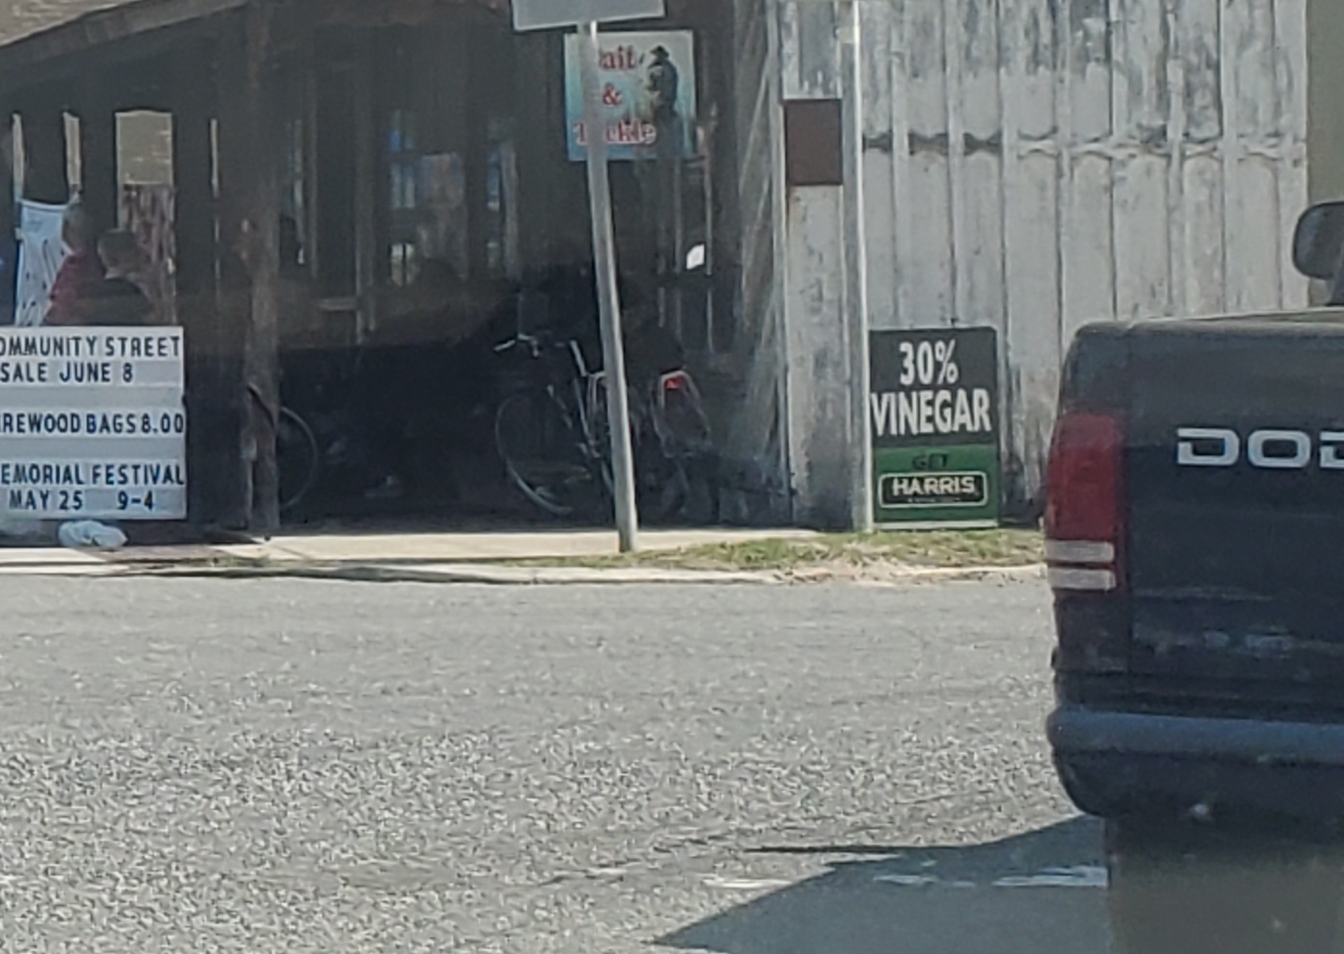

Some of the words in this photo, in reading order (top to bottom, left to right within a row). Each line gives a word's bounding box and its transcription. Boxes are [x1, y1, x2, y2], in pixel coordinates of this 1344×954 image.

[599, 44, 637, 70] ait
[603, 82, 623, 107] &
[573, 119, 657, 145] Tckle
[105, 335, 181, 357] STREET
[0, 362, 48, 383] SALE
[59, 362, 111, 383] JUNE
[122, 362, 133, 383] 8
[899, 339, 959, 386] 30%
[86, 413, 136, 434] BAGS
[141, 413, 184, 435] 8.00
[870, 388, 992, 437] VINEGAR
[92, 463, 185, 486] FESTIVAL
[892, 476, 976, 496] HARRIS
[9, 489, 50, 511] MAY
[58, 490, 83, 511] 25
[116, 490, 154, 511] 9-4
